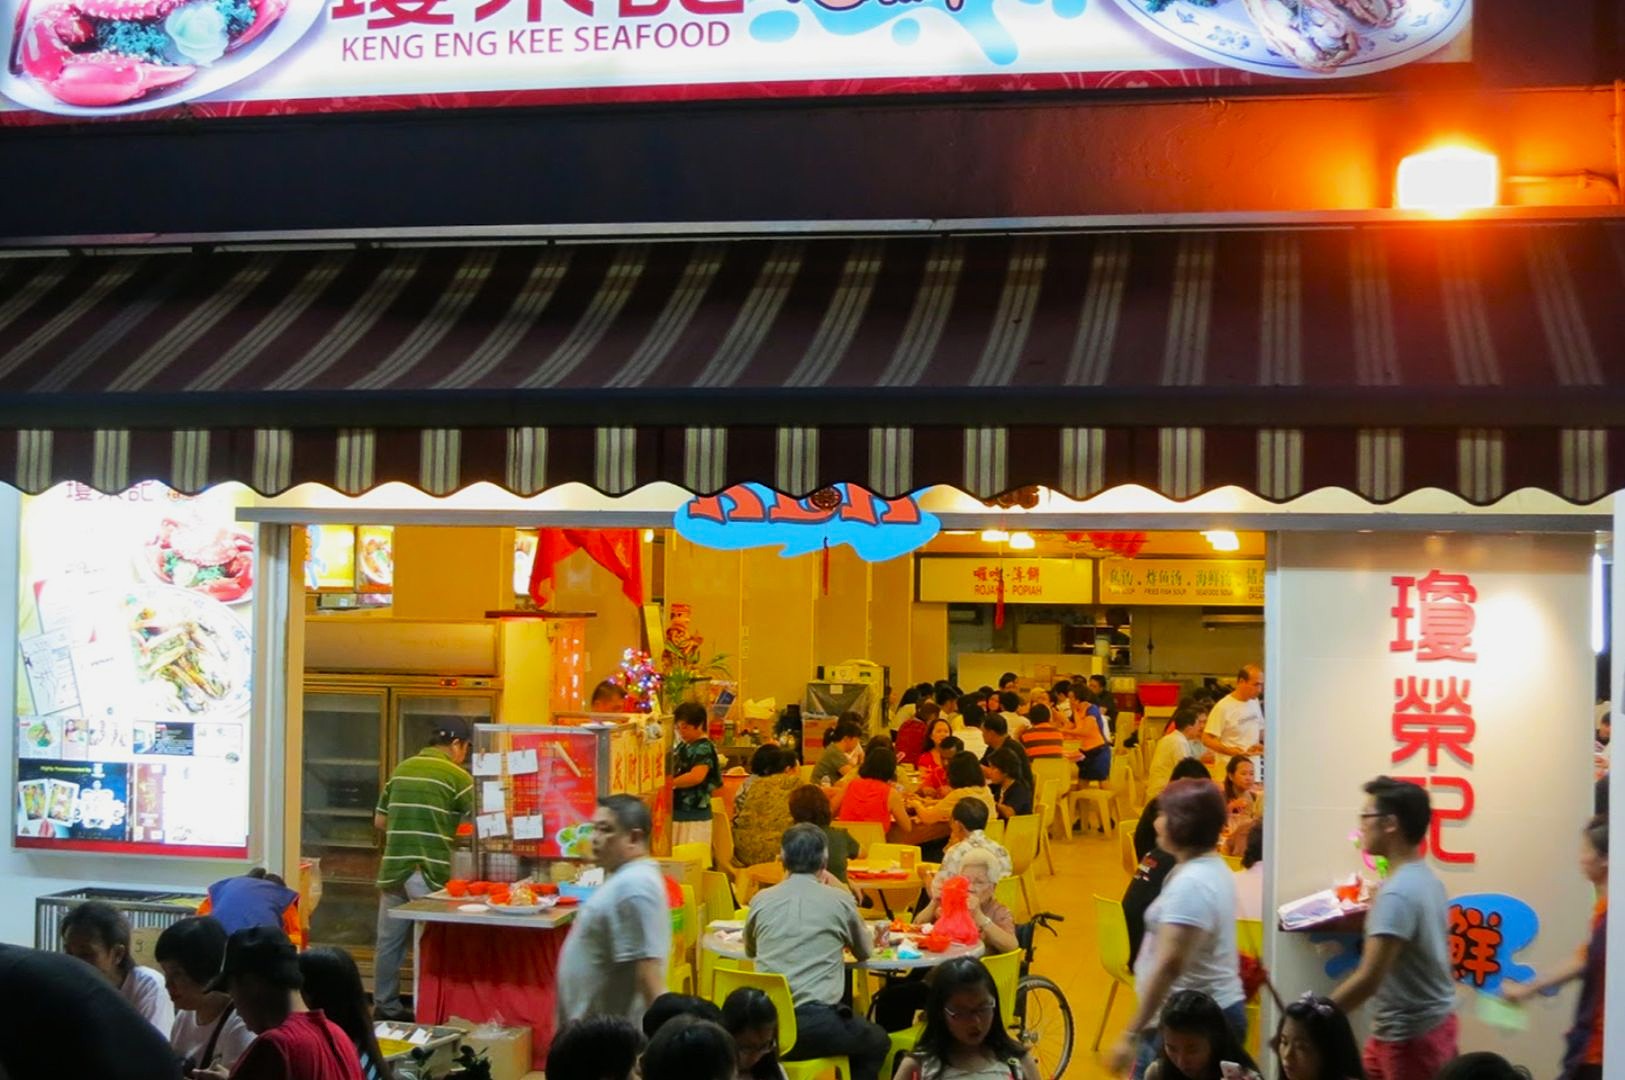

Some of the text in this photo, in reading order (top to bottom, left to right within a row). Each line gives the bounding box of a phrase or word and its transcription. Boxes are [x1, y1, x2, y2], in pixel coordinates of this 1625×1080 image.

[342, 21, 730, 61] KENG ENG KEE SEAFOOD
[975, 584, 1003, 595] ROJA
